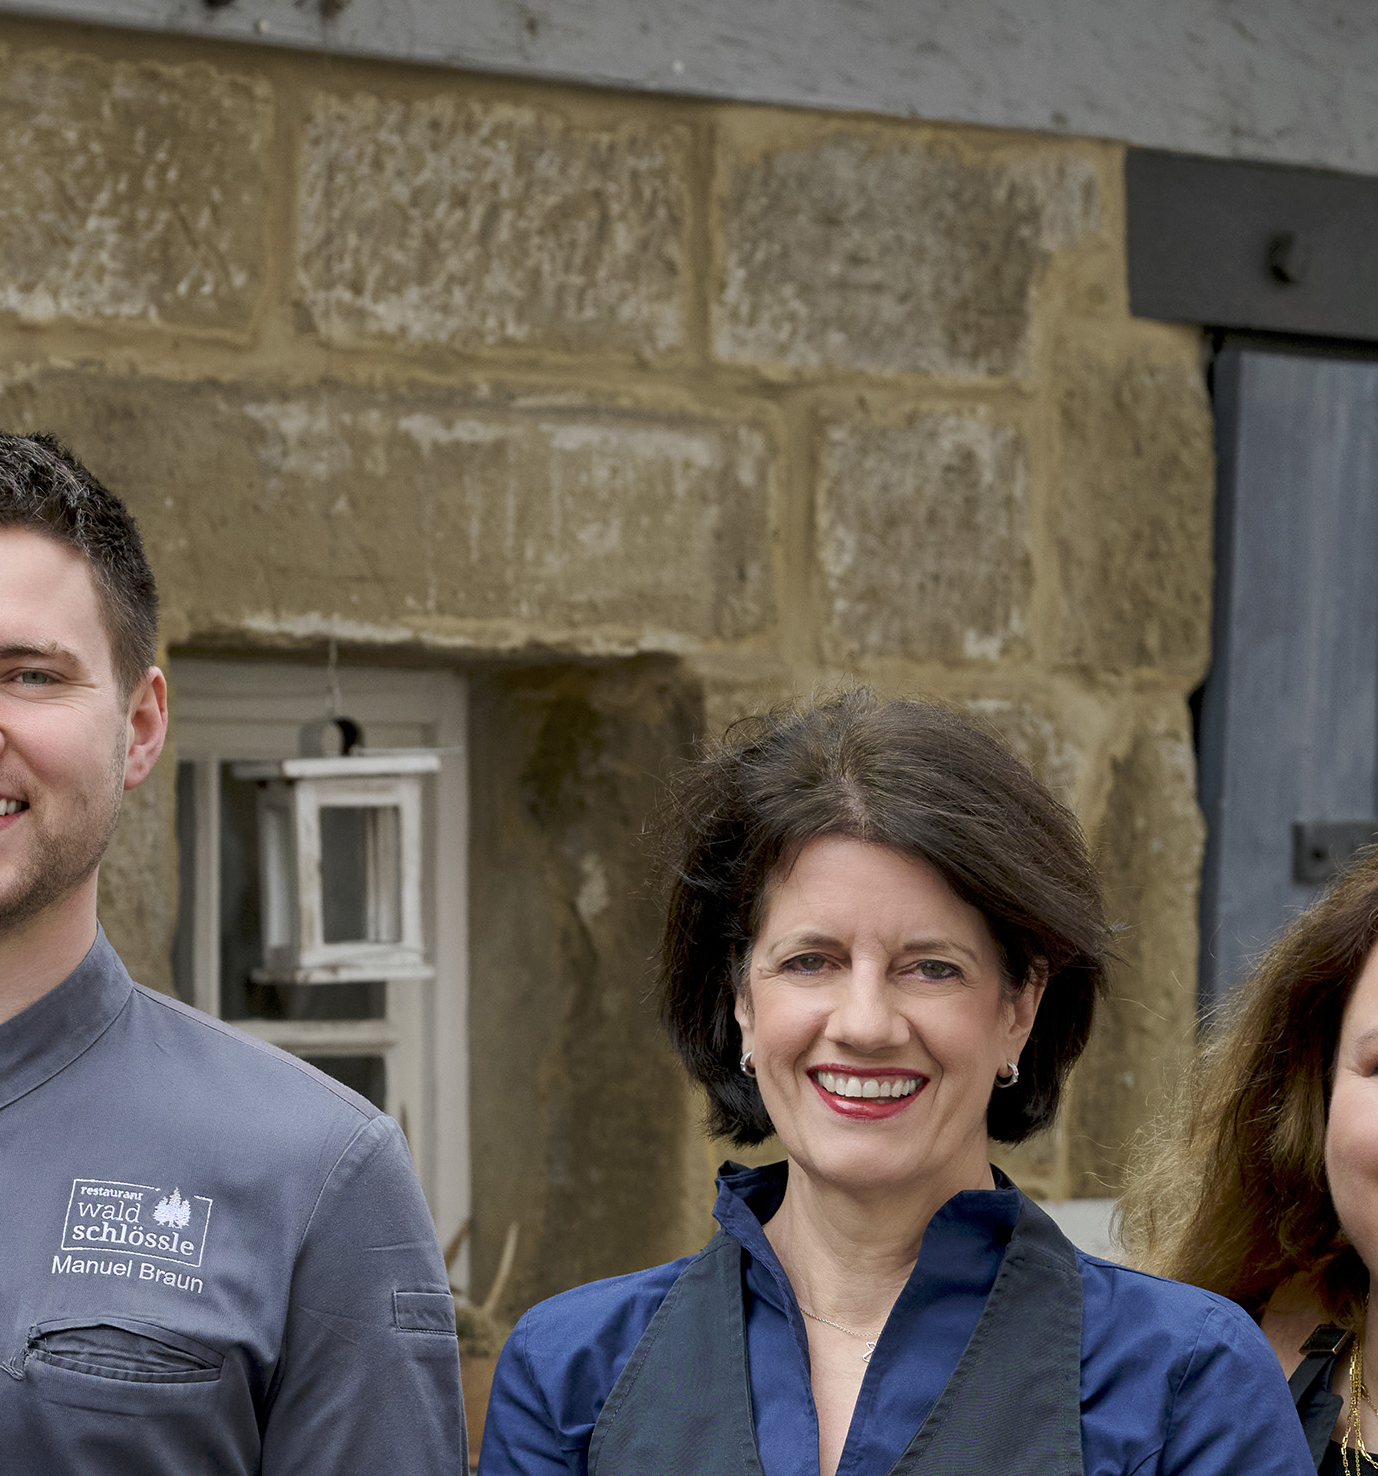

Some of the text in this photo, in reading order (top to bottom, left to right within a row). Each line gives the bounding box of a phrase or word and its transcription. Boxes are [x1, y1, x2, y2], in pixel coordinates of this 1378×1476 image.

[77, 1201, 141, 1223] wald
[72, 1222, 195, 1256] schlössle
[51, 1255, 203, 1294] Manuel Braun
